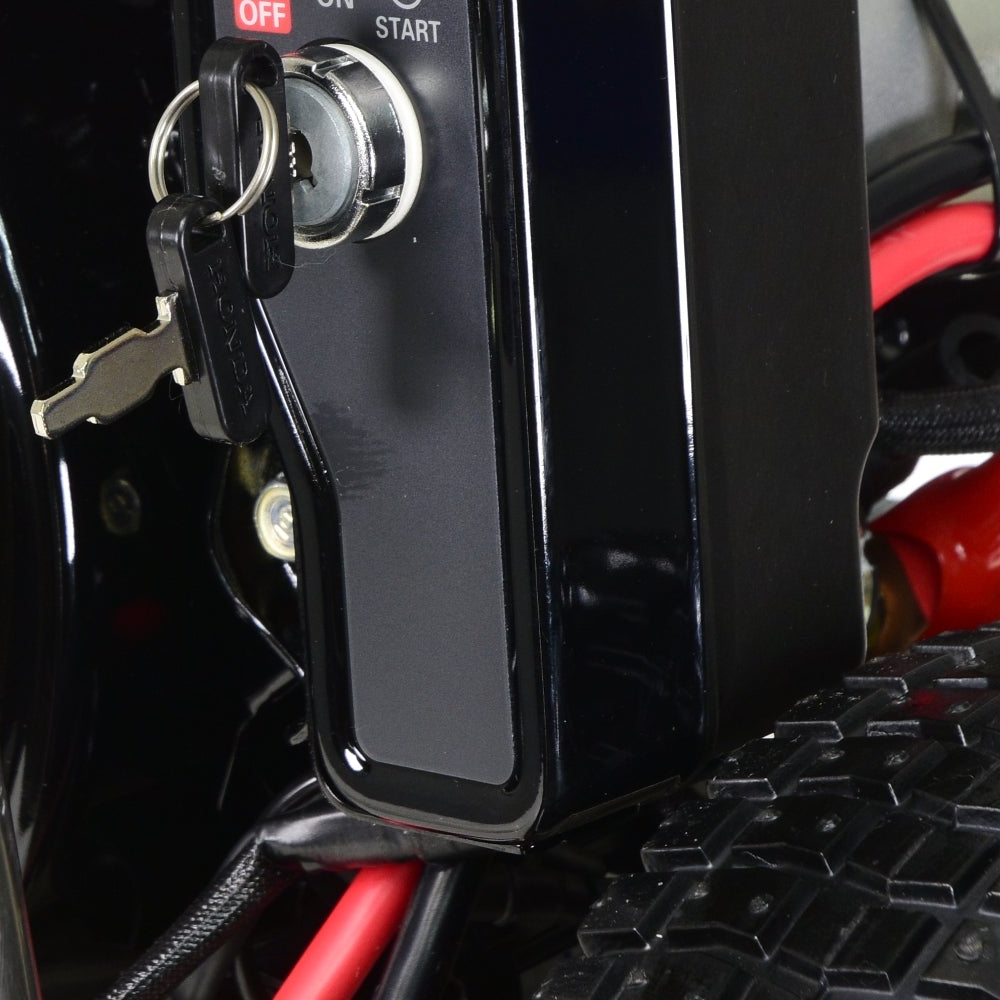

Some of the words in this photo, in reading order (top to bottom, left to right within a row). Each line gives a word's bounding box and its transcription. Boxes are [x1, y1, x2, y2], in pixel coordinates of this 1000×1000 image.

[238, 0, 287, 29] OFF
[374, 15, 442, 44] START
[207, 257, 255, 417] HONDA
